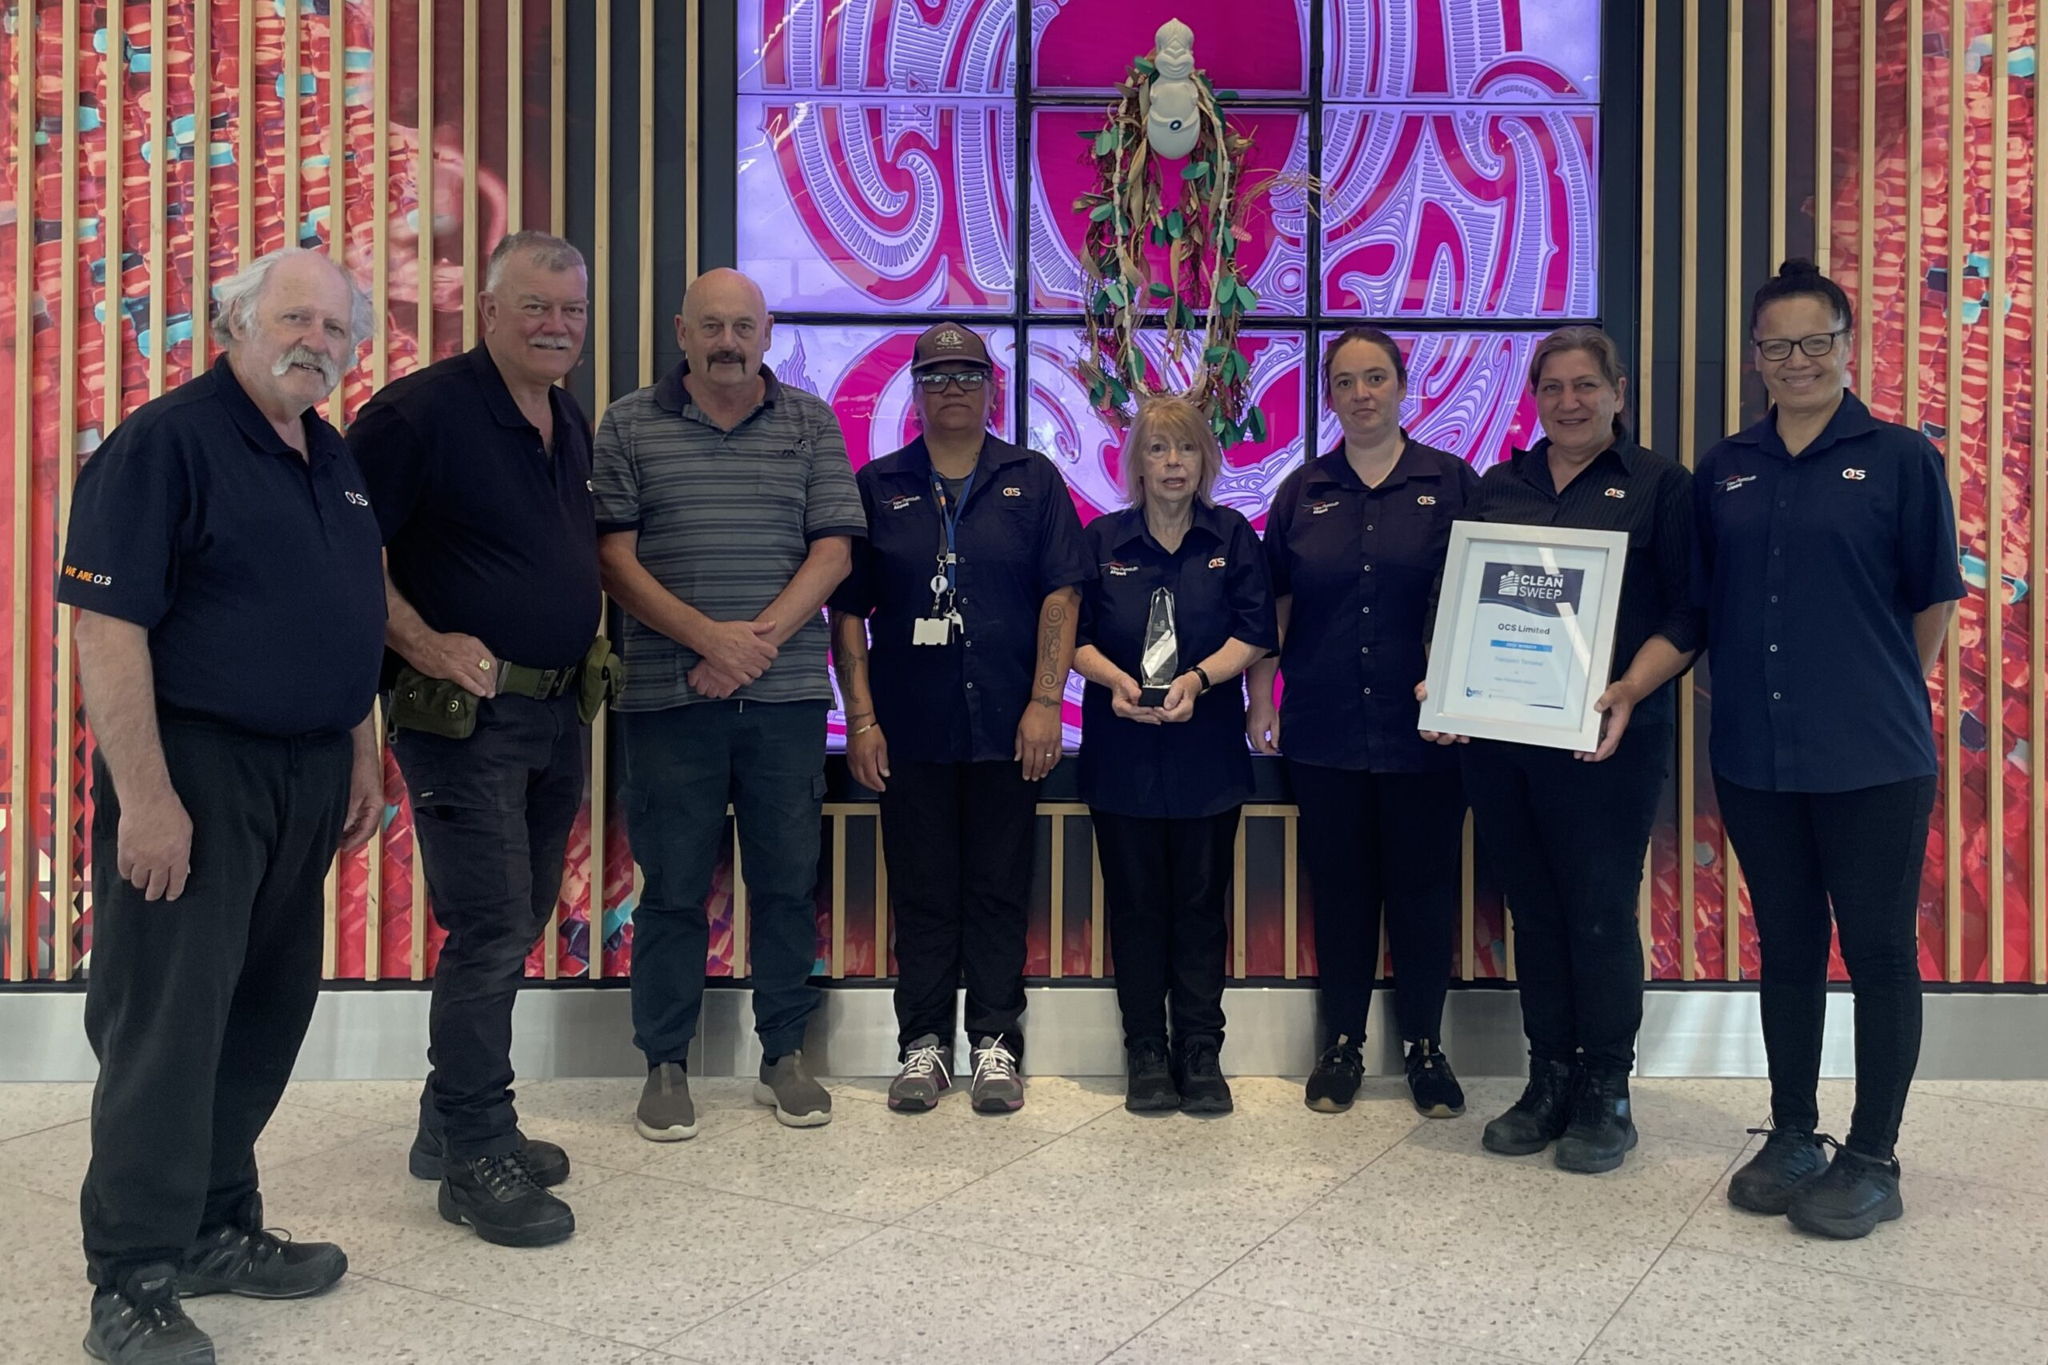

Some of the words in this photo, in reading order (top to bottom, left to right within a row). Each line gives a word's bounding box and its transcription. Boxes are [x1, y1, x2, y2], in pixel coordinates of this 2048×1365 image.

[65, 565, 77, 577] WE
[76, 570, 94, 582] ARE
[1520, 574, 1563, 588] CLEAN
[1518, 586, 1562, 600] SWEEP
[1498, 623, 1517, 631] OCS
[1518, 625, 1550, 635] Limited
